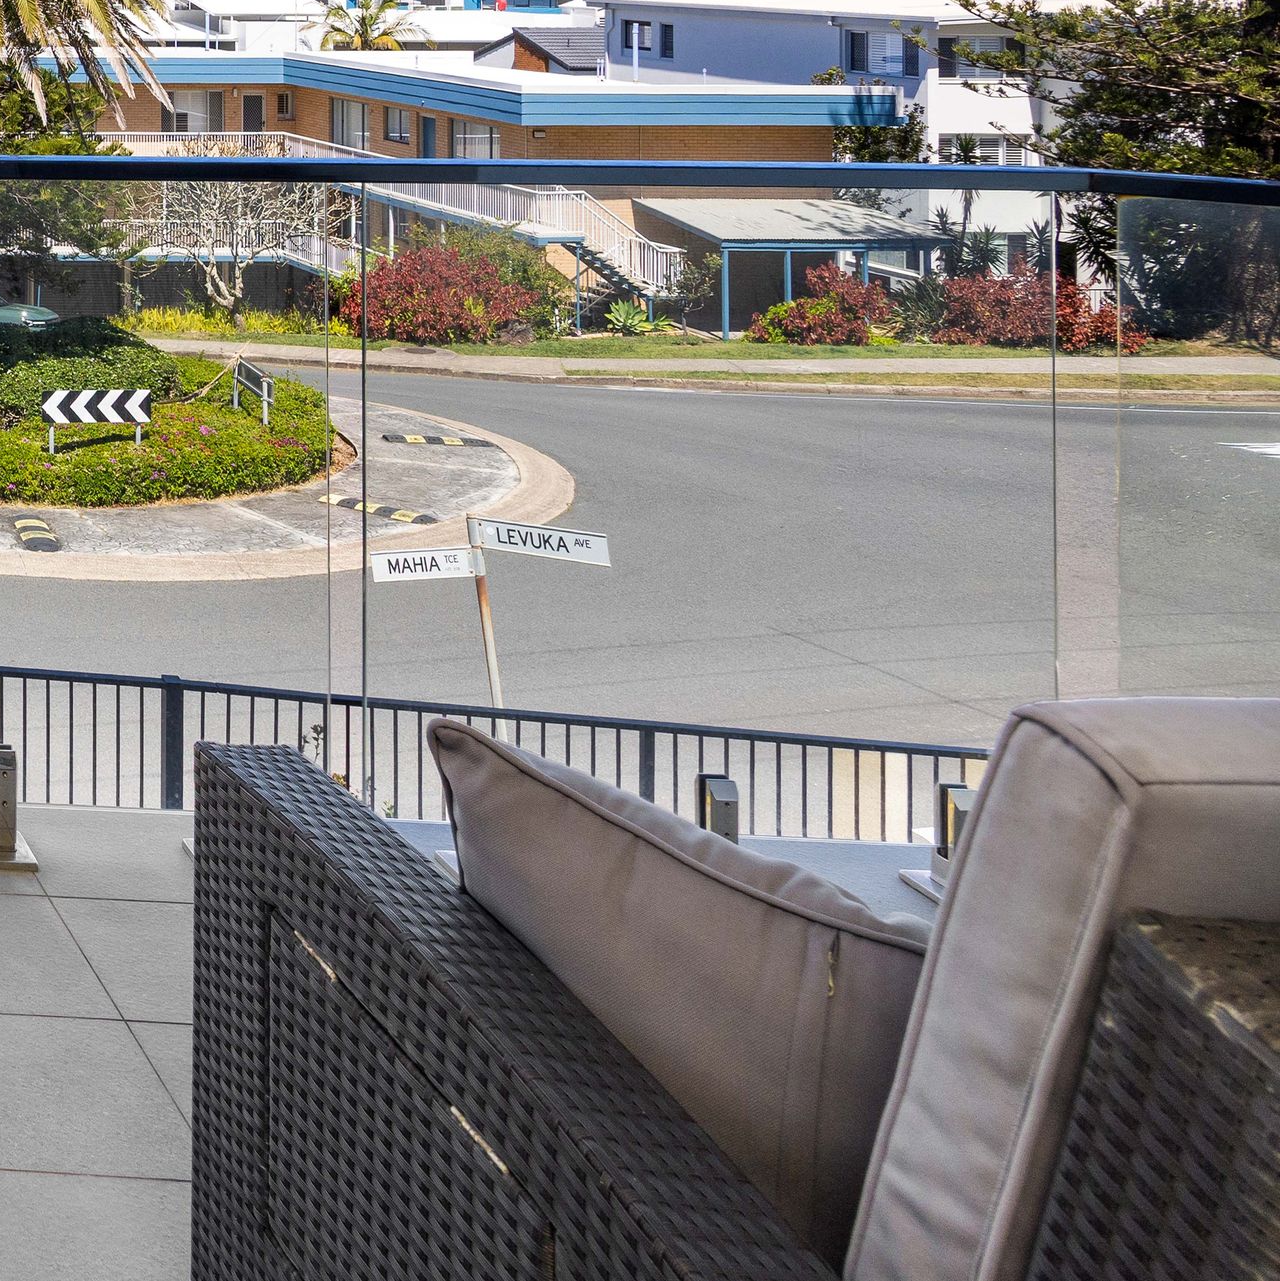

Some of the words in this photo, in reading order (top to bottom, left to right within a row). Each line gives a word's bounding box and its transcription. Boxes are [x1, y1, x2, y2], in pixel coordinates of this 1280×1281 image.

[496, 527, 570, 553] LEVUKA
[574, 538, 592, 549] AVE
[387, 556, 441, 574] MAHIA
[444, 554, 459, 563] TCE
